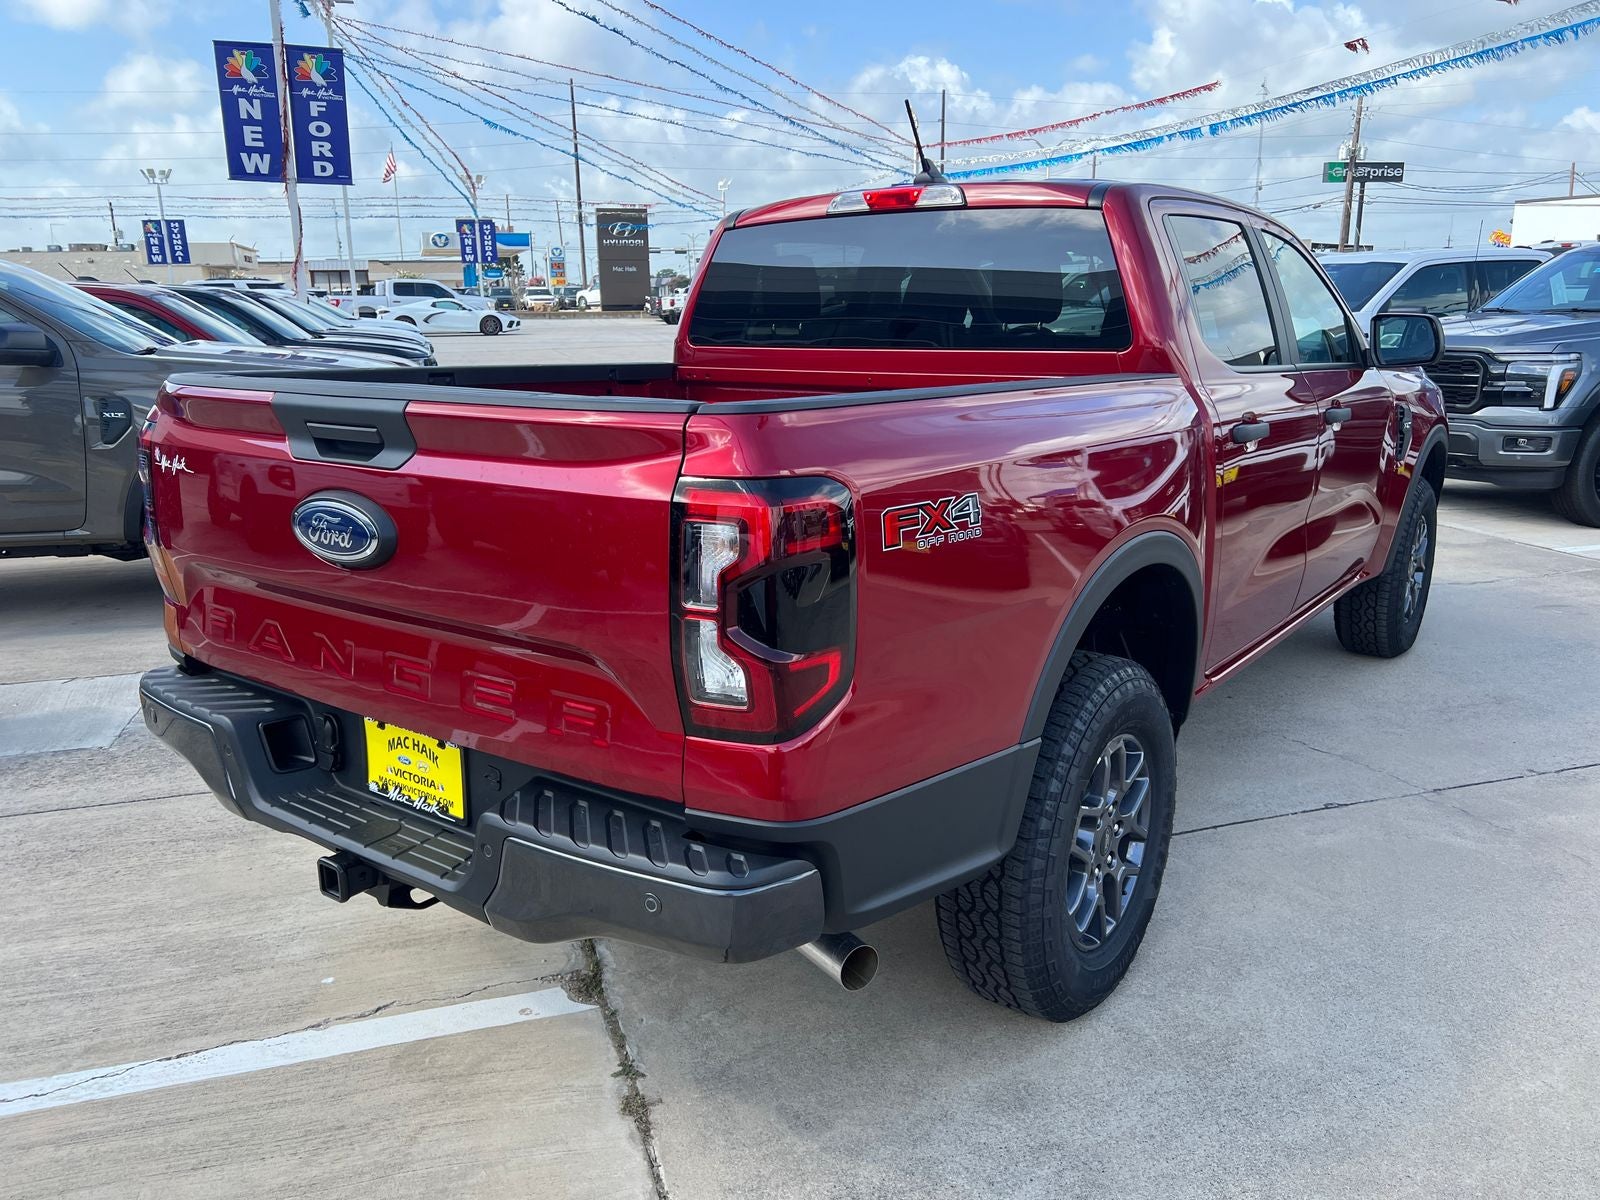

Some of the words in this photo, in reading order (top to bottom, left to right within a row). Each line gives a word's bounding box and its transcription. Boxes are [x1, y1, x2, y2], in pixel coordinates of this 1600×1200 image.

[237, 97, 271, 175] NEW
[308, 100, 334, 177] FORD
[149, 237, 162, 263] NEW
[170, 222, 184, 262] HYUNDAI
[464, 237, 475, 262] NEW
[483, 224, 493, 262] HYUNDAI
[603, 239, 644, 247] HYUNDAI
[308, 512, 353, 549] Ford
[881, 492, 982, 551] FX4
[916, 535, 945, 550] OFF
[948, 527, 983, 544] ROAD
[202, 602, 614, 749] RANGER
[387, 736, 410, 752] MAC
[412, 738, 440, 768] HAIK
[393, 766, 437, 791] VICTORIA
